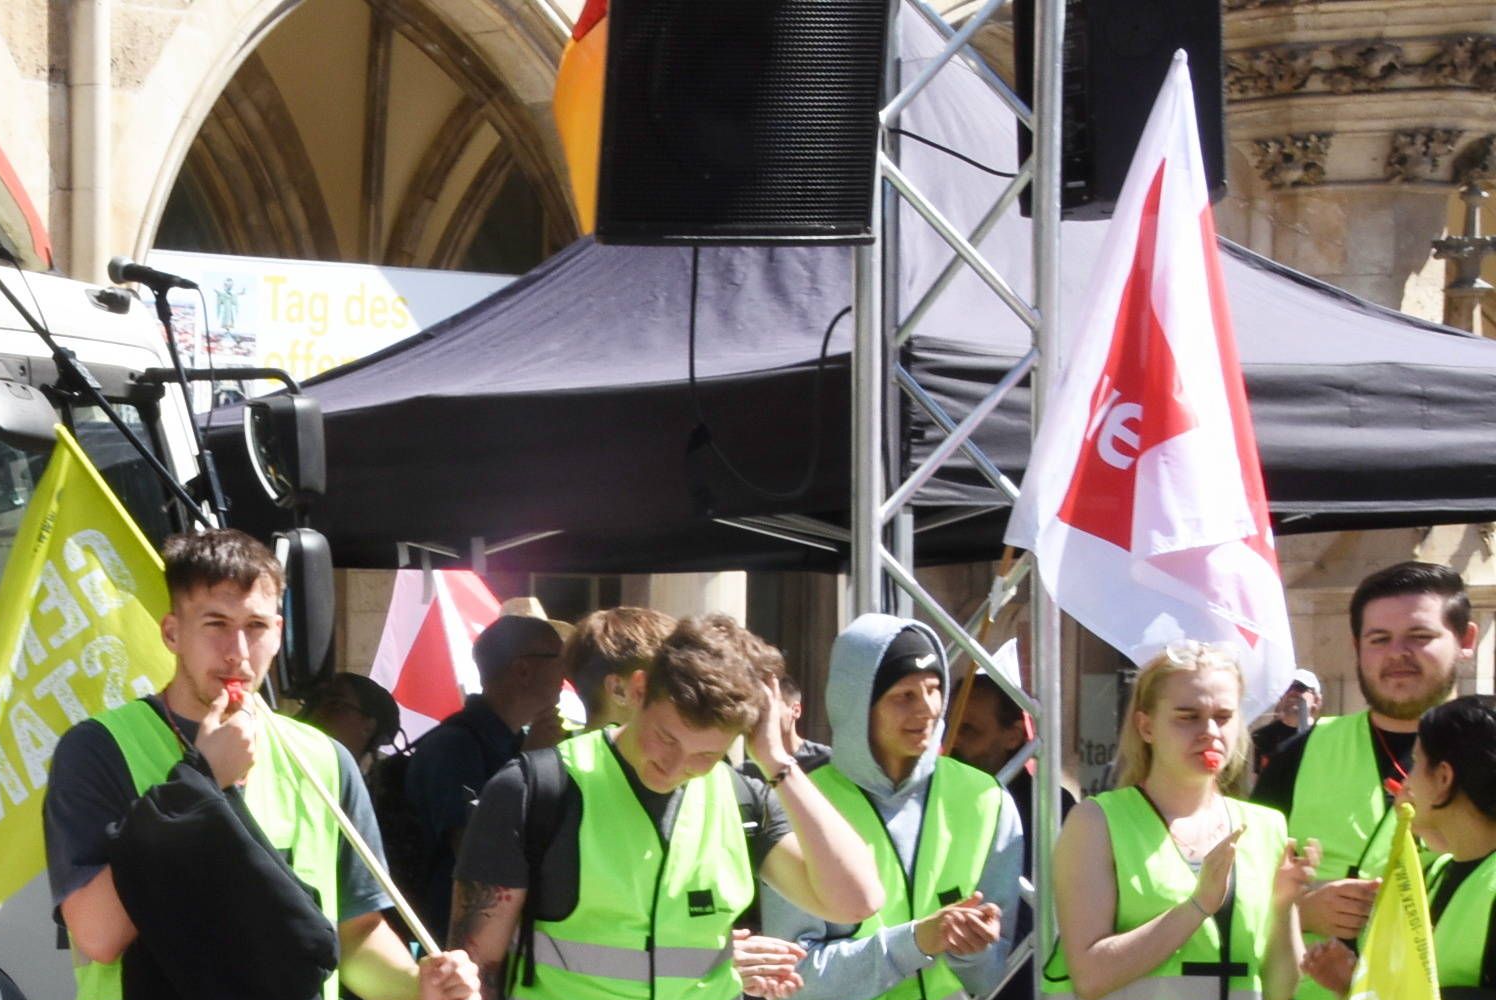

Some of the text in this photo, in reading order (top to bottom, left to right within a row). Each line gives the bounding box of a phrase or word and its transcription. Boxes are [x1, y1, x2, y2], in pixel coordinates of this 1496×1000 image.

[264, 275, 409, 336] Tag des
[264, 339, 360, 385] offe
